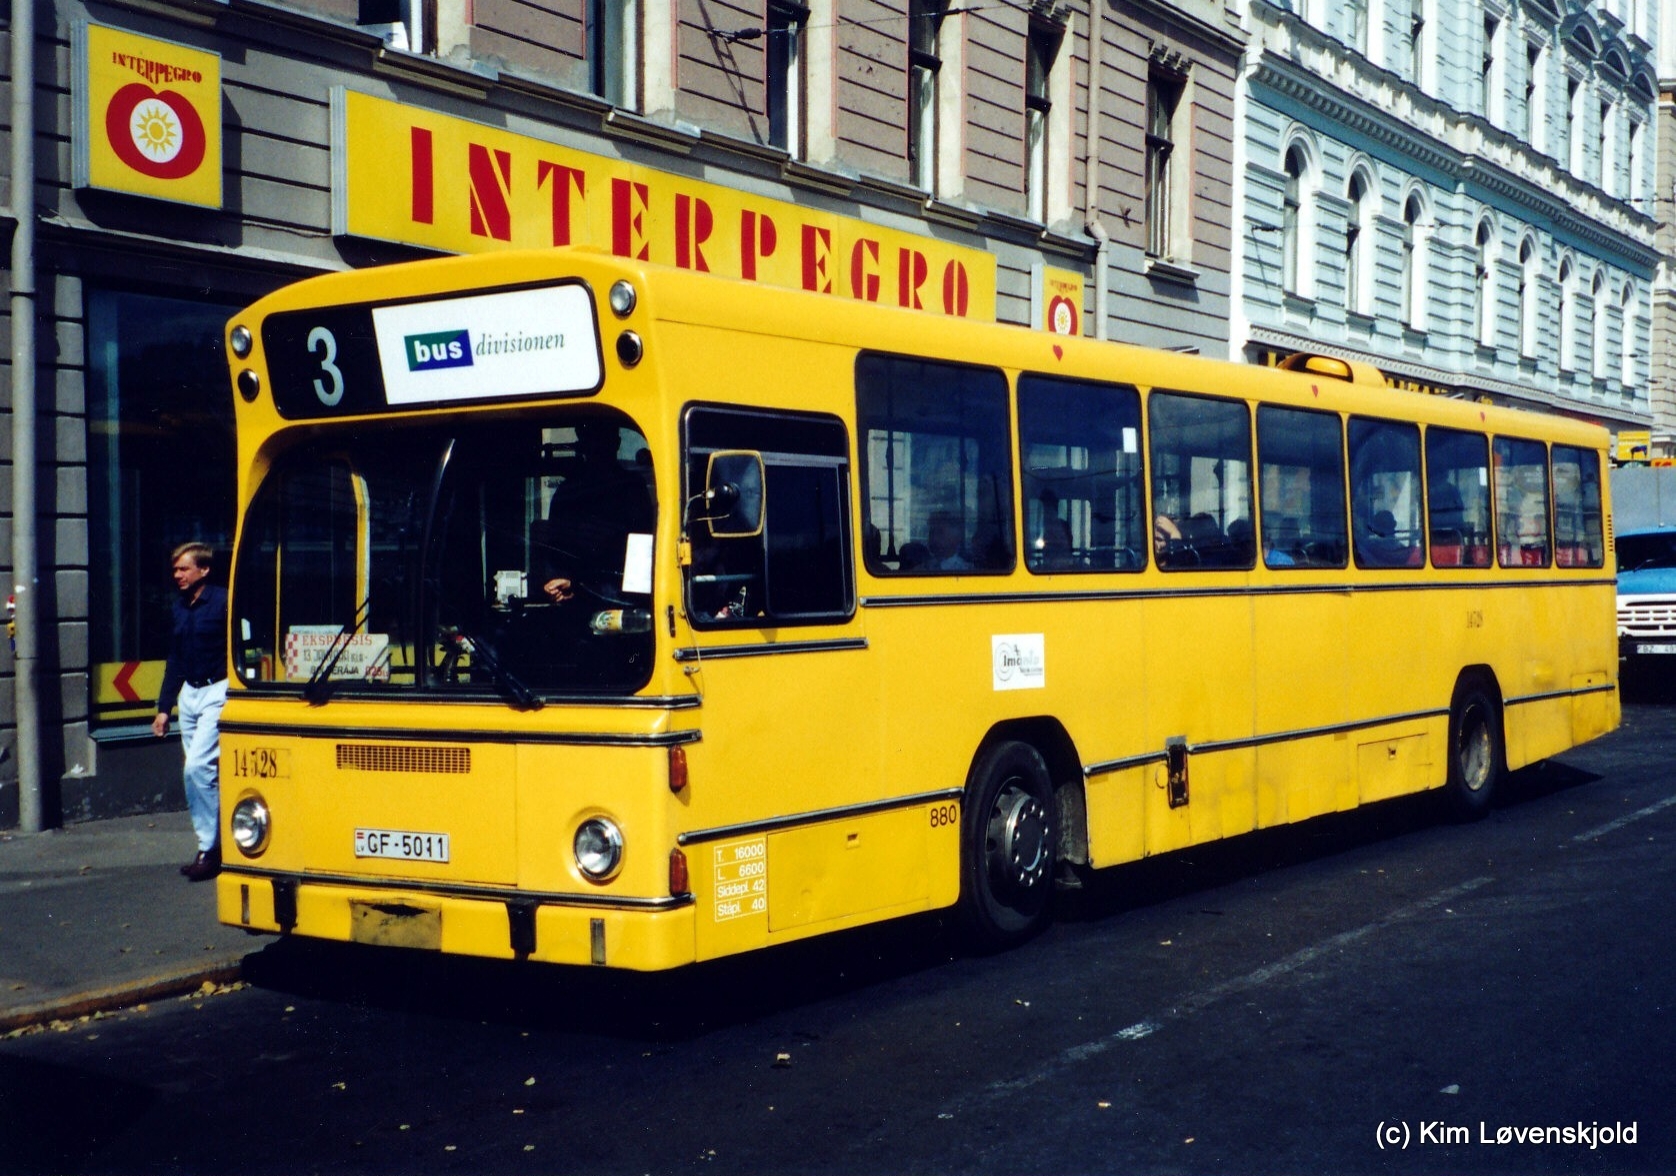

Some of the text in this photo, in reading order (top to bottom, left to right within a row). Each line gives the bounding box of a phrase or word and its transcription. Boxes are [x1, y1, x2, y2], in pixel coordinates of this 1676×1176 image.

[112, 52, 202, 84] INTERPEGRO
[411, 126, 968, 317] INTERPEGRO
[414, 331, 565, 363] bus divisionen
[307, 326, 345, 406] 3
[930, 804, 957, 828] 880
[734, 843, 764, 860] 16000
[739, 861, 764, 877] 6600
[752, 879, 765, 891] 42
[751, 897, 765, 910] 40
